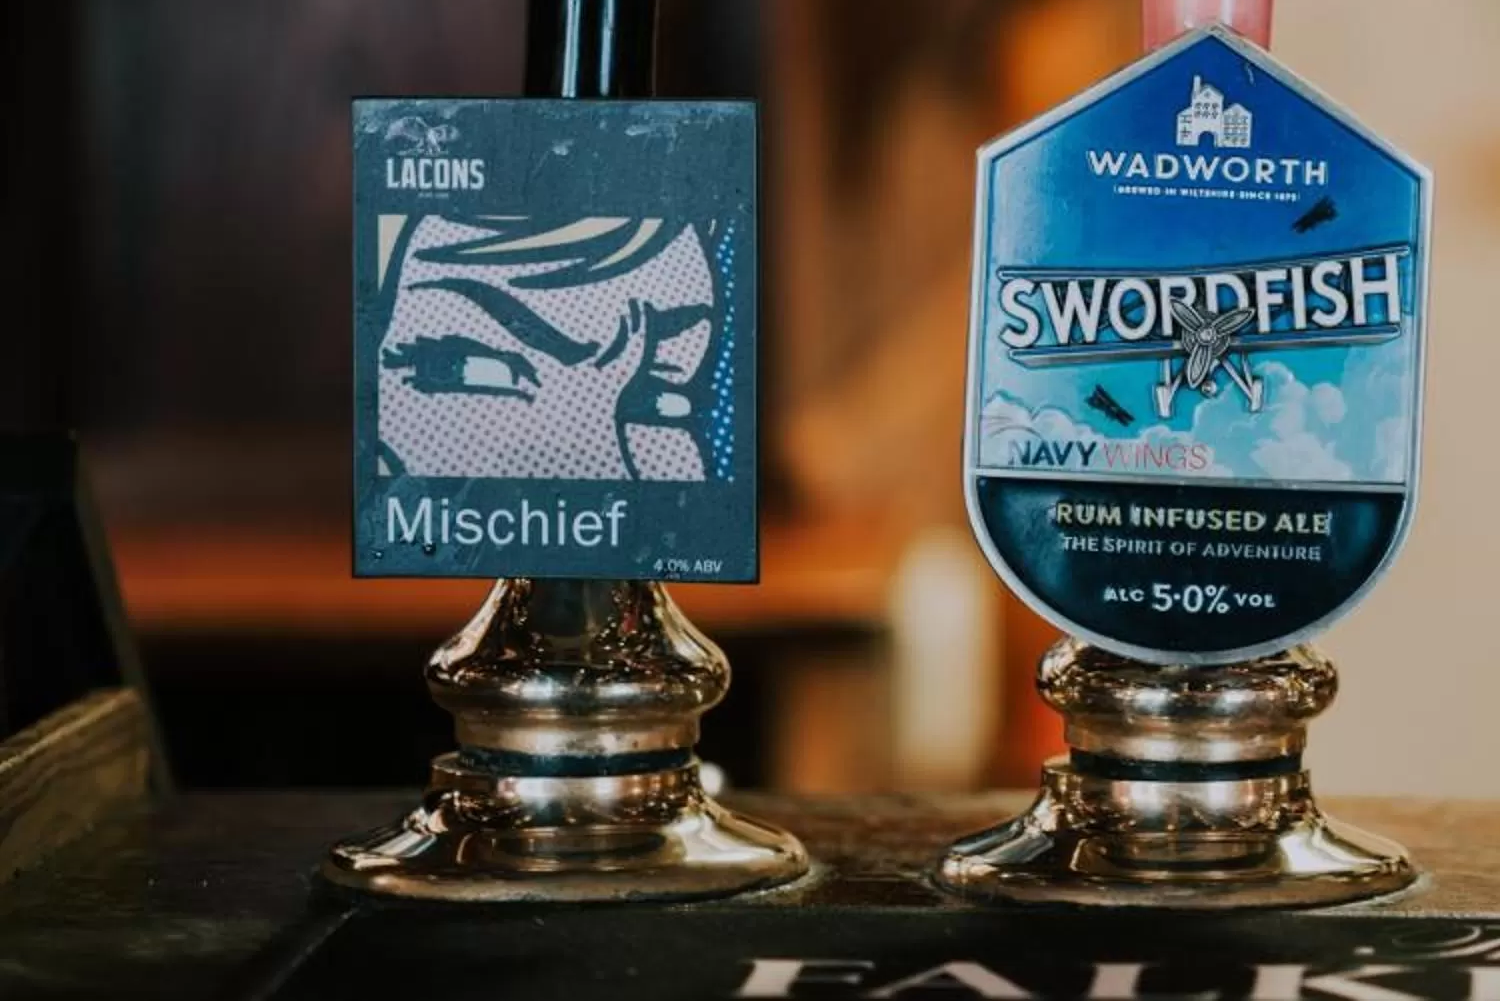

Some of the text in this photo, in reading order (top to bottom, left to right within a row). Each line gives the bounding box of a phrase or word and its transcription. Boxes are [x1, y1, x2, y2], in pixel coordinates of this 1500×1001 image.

[386, 157, 485, 190] LACONS
[1088, 151, 1328, 185] WADWORTH
[999, 254, 1401, 348] SWORDFISH
[1008, 440, 1209, 471] NAVY WINGS
[387, 497, 627, 546] Mischief
[1056, 502, 1332, 535] RUM INFUSED ALE
[1062, 536, 1322, 561] THE SPIRIT OF ADVENTURE
[653, 558, 724, 574] 4.0% ABV
[1103, 585, 1145, 602] ALC
[1233, 592, 1276, 608] VOL
